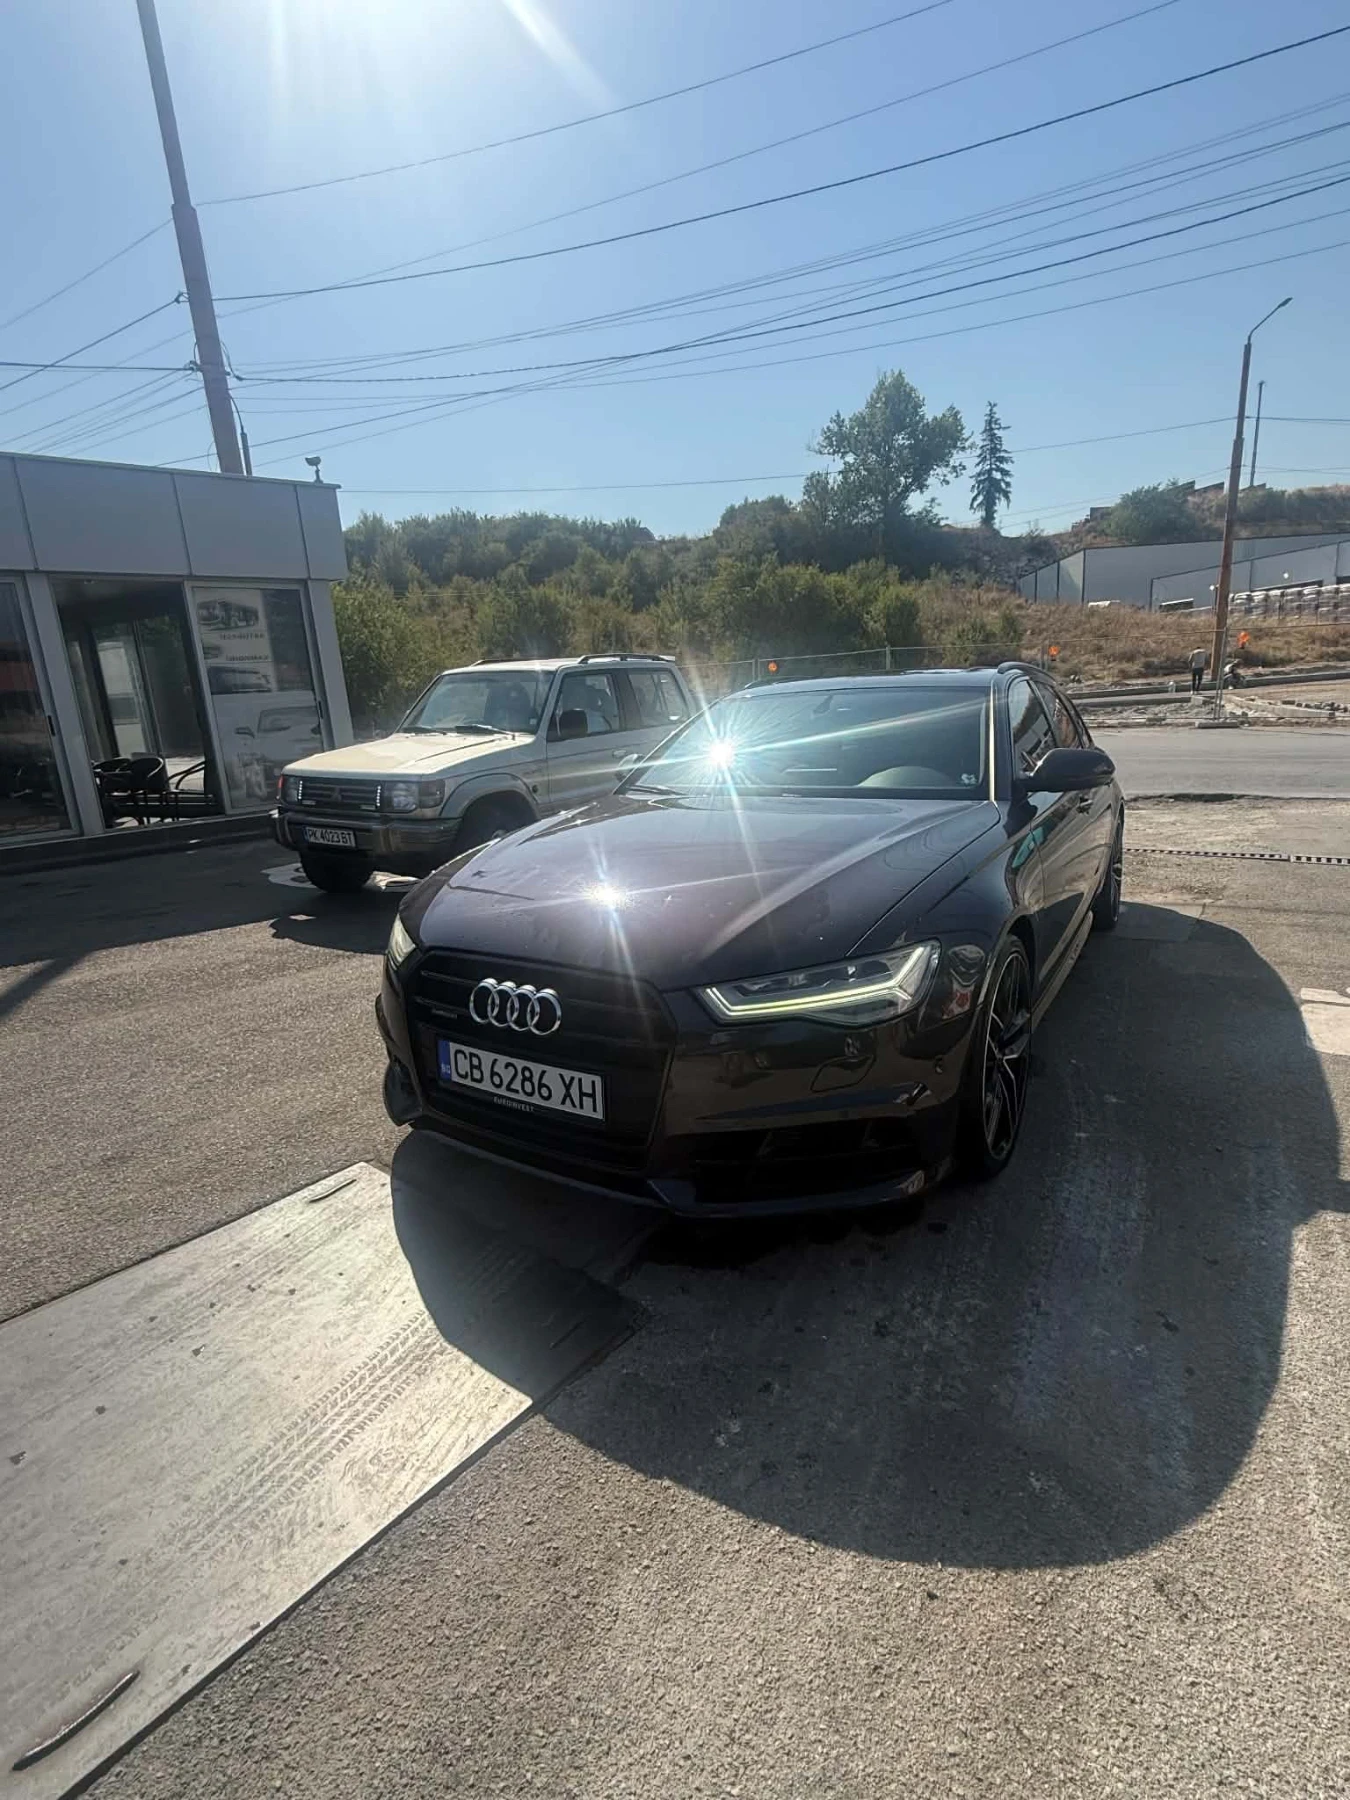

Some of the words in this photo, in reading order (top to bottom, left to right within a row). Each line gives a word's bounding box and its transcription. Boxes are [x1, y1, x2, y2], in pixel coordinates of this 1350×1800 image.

[308, 828, 320, 842] PK
[320, 829, 340, 844] 4023
[340, 831, 352, 845] BT
[454, 1049, 484, 1084] CB
[490, 1058, 553, 1101] 6286
[558, 1072, 598, 1113] XH
